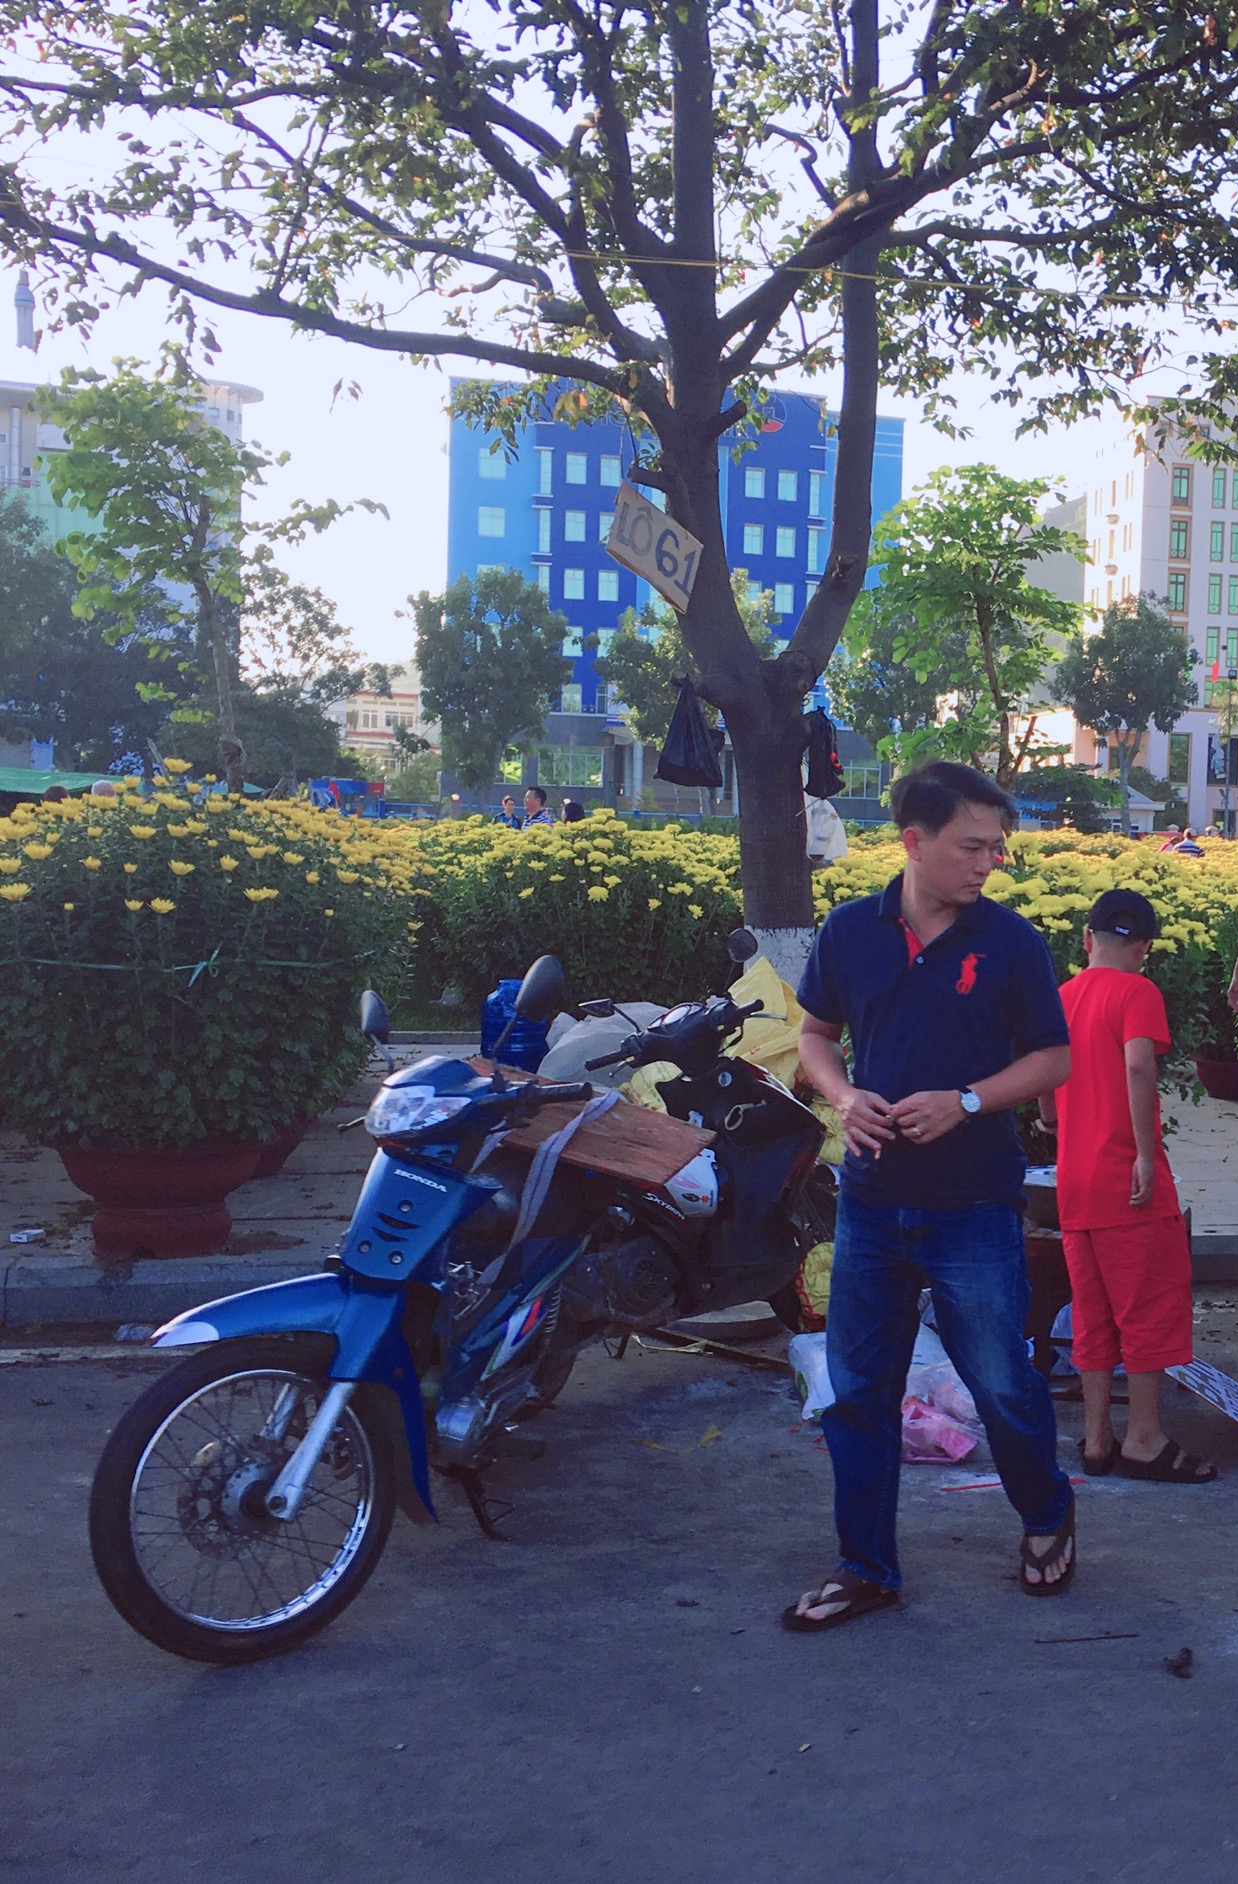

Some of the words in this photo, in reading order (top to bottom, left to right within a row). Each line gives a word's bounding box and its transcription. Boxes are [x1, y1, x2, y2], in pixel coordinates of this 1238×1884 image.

[616, 502, 653, 557] LÔ
[655, 528, 697, 596] 61
[393, 1168, 448, 1193] HONDA
